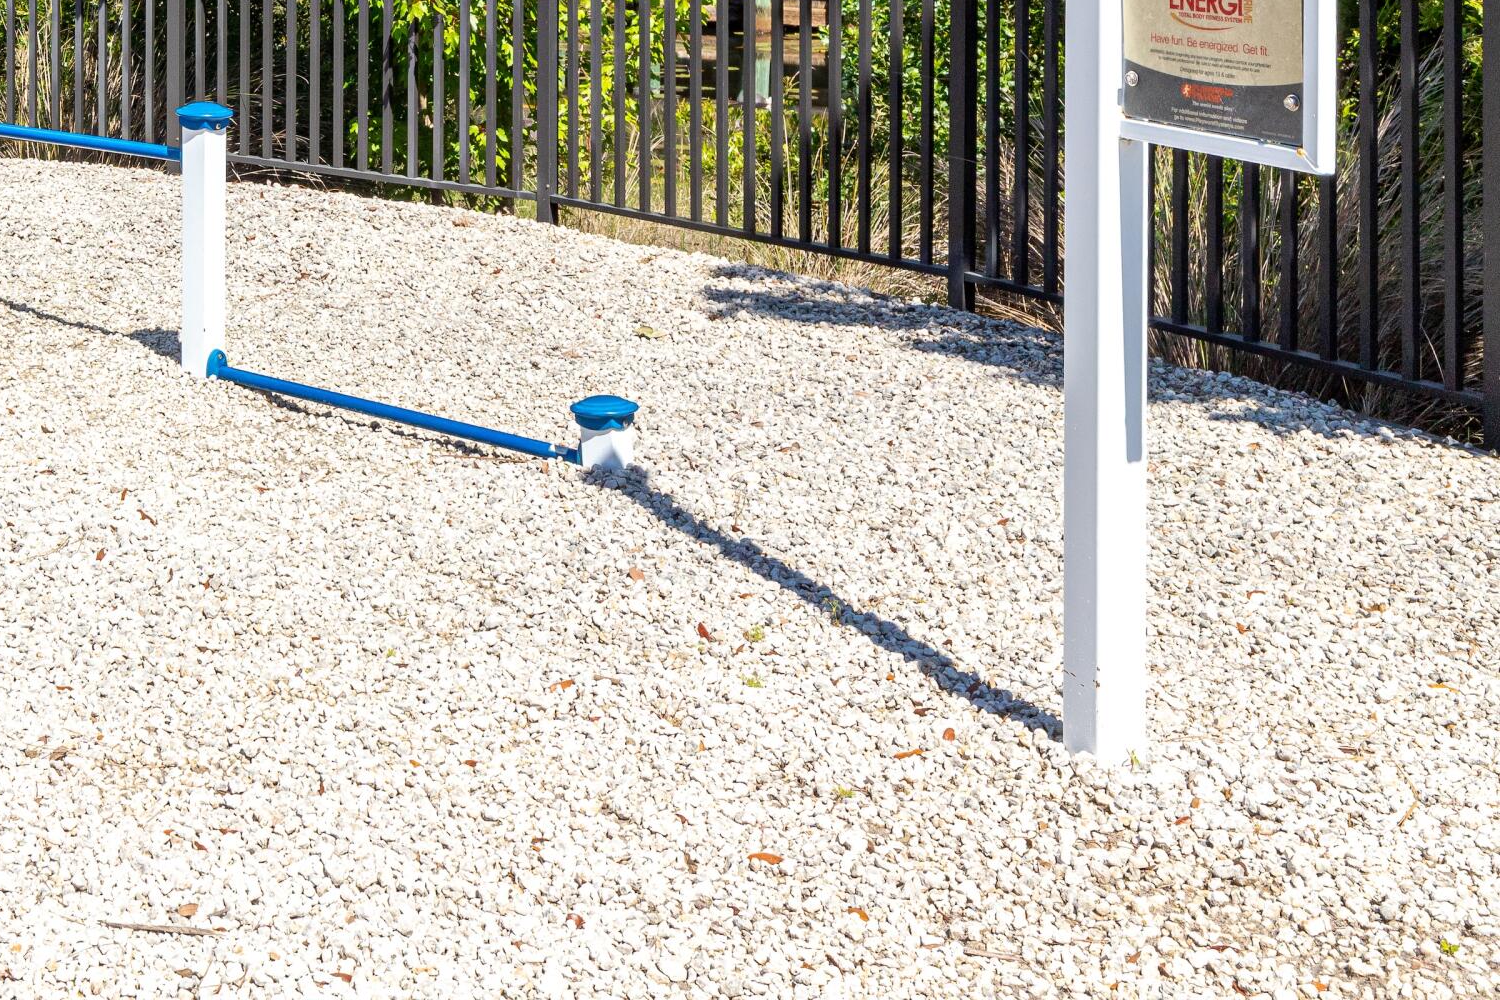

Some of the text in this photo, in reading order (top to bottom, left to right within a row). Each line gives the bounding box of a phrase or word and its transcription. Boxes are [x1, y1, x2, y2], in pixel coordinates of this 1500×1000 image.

[1224, 16, 1243, 24] SYSTEM
[1150, 32, 1270, 56] Have fun. Be energized. Get fit.
